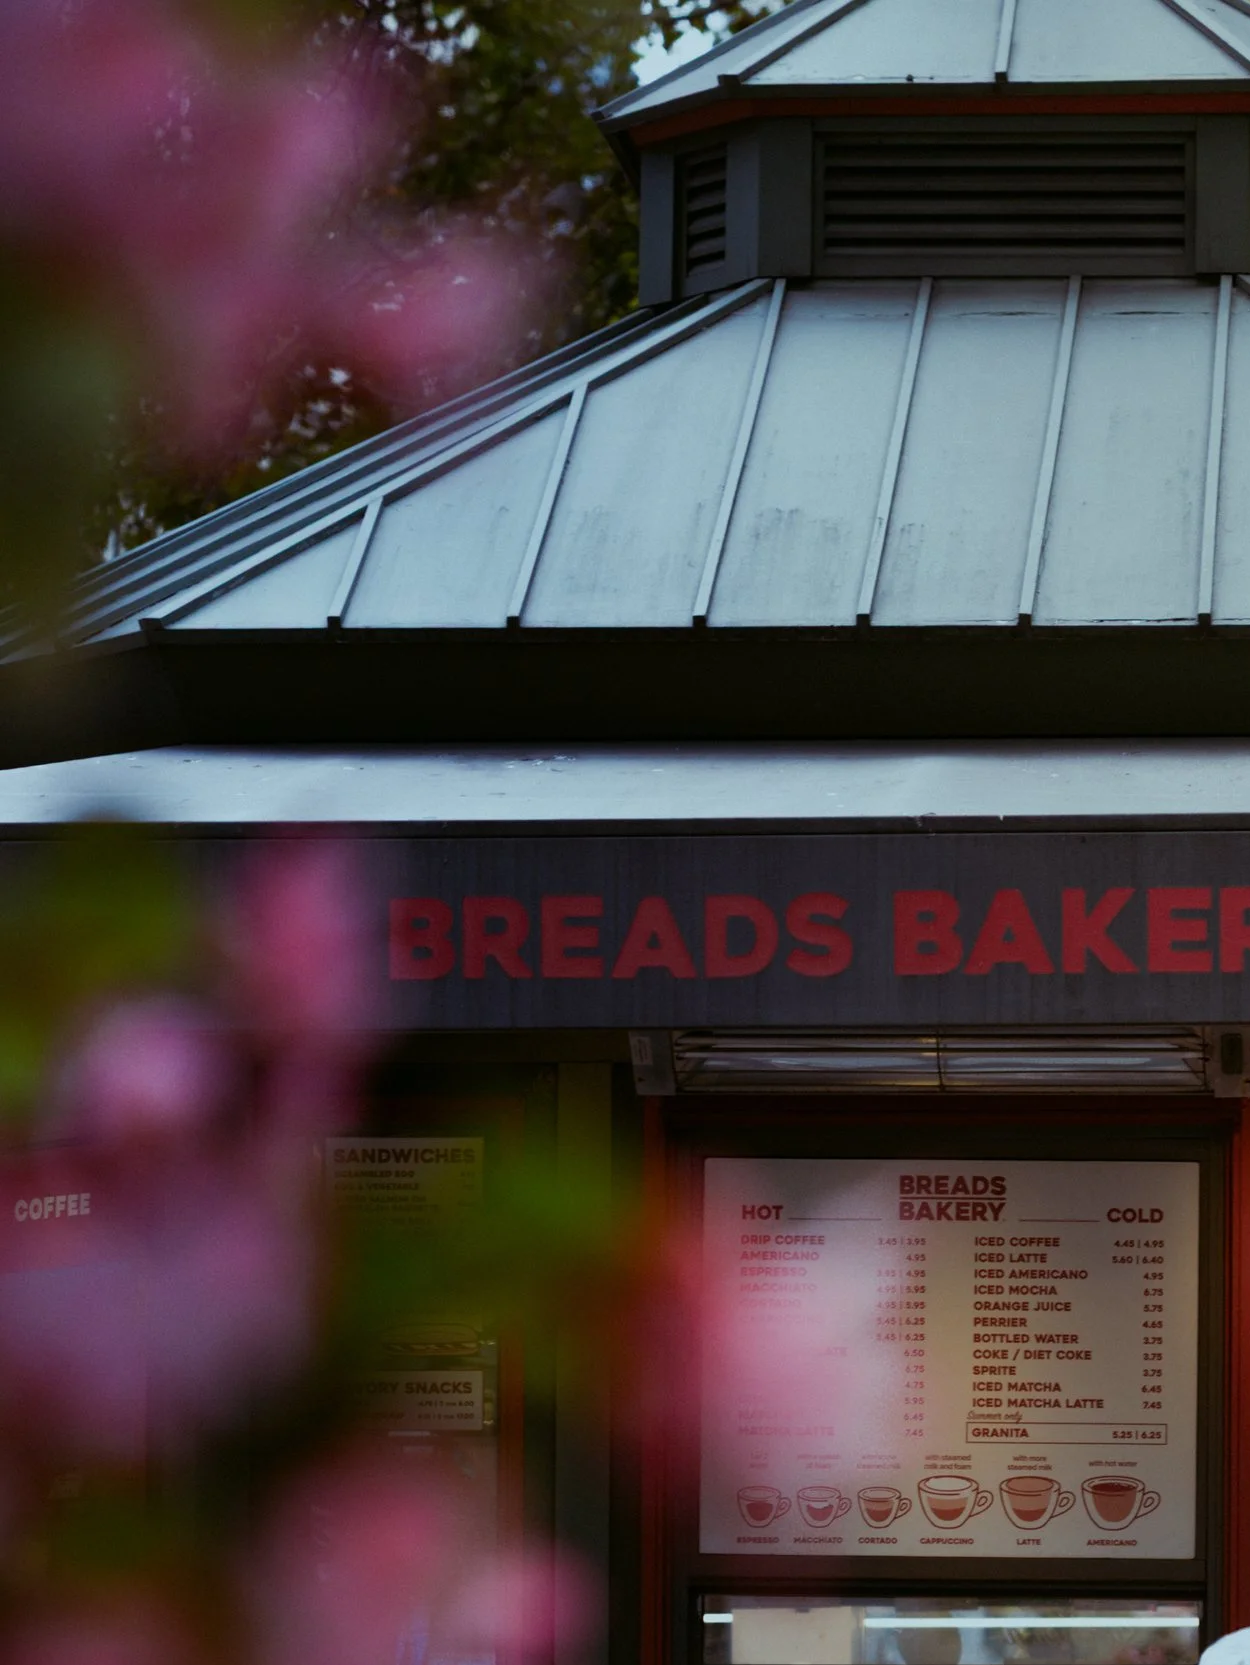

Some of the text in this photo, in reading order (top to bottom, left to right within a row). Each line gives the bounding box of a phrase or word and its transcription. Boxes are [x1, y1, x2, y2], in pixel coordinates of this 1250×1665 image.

[388, 893, 856, 979] BREADS
[333, 1148, 475, 1164] SANDWICHES
[900, 1176, 1006, 1195] BREADS
[14, 1193, 91, 1222] COFFEE
[899, 1202, 1006, 1221] BAKERY
[741, 1205, 783, 1221] HOT
[1107, 1208, 1164, 1224] COLD
[740, 1234, 825, 1246] DRIP COFFEE
[974, 1236, 1060, 1248] ICED COFFEE
[1114, 1239, 1164, 1248] 4.45 4.95
[739, 1251, 820, 1262] AMERICANO
[905, 1253, 926, 1262] 4.95
[974, 1253, 1047, 1264] ICED LATTE
[1112, 1256, 1164, 1265] 5.60 6.40
[740, 1267, 808, 1278] ESPRESSO
[905, 1269, 926, 1278] 4.95
[974, 1269, 1088, 1280] ICED AMERICANO
[1143, 1272, 1164, 1280] 4.95
[974, 1285, 1058, 1296] ICED MOCHA
[1143, 1287, 1163, 1297] 6.75
[973, 1301, 1071, 1312] ORANGE JUICE
[1143, 1304, 1163, 1313] 5.75
[905, 1317, 925, 1326] 6.25
[973, 1317, 1027, 1328] PERRIER
[1142, 1320, 1163, 1329] 4.65
[904, 1333, 925, 1342] 6.25
[973, 1333, 1079, 1345] BOTTLED WATER
[904, 1349, 924, 1358] 6.50
[972, 1350, 1092, 1362] COKE / DIET COKE
[904, 1365, 924, 1374] 6.75
[972, 1365, 1016, 1376] SPRITE
[404, 1382, 472, 1394] SNACKS
[972, 1382, 1061, 1393] ICED MATCHA
[1141, 1384, 1162, 1393] 6.45
[904, 1397, 924, 1405] 5.95
[972, 1398, 1104, 1409] ICED MATCHA LATTE
[1143, 1400, 1162, 1410] 7.45
[903, 1412, 924, 1421] 6.45
[967, 1411, 1023, 1424] Summer only
[905, 1429, 924, 1437] 7.45
[972, 1427, 1029, 1438] GRANITA
[1112, 1430, 1162, 1439] 5.25 6.25
[944, 1454, 972, 1462] steamed
[736, 1536, 780, 1545] ESPRESSO
[793, 1536, 843, 1545] MACCHIATO
[858, 1537, 898, 1545] CORTADO
[919, 1538, 974, 1546] CAPPUCCINO
[1016, 1538, 1041, 1546] LATTE
[1086, 1538, 1138, 1547] AMERICANO
